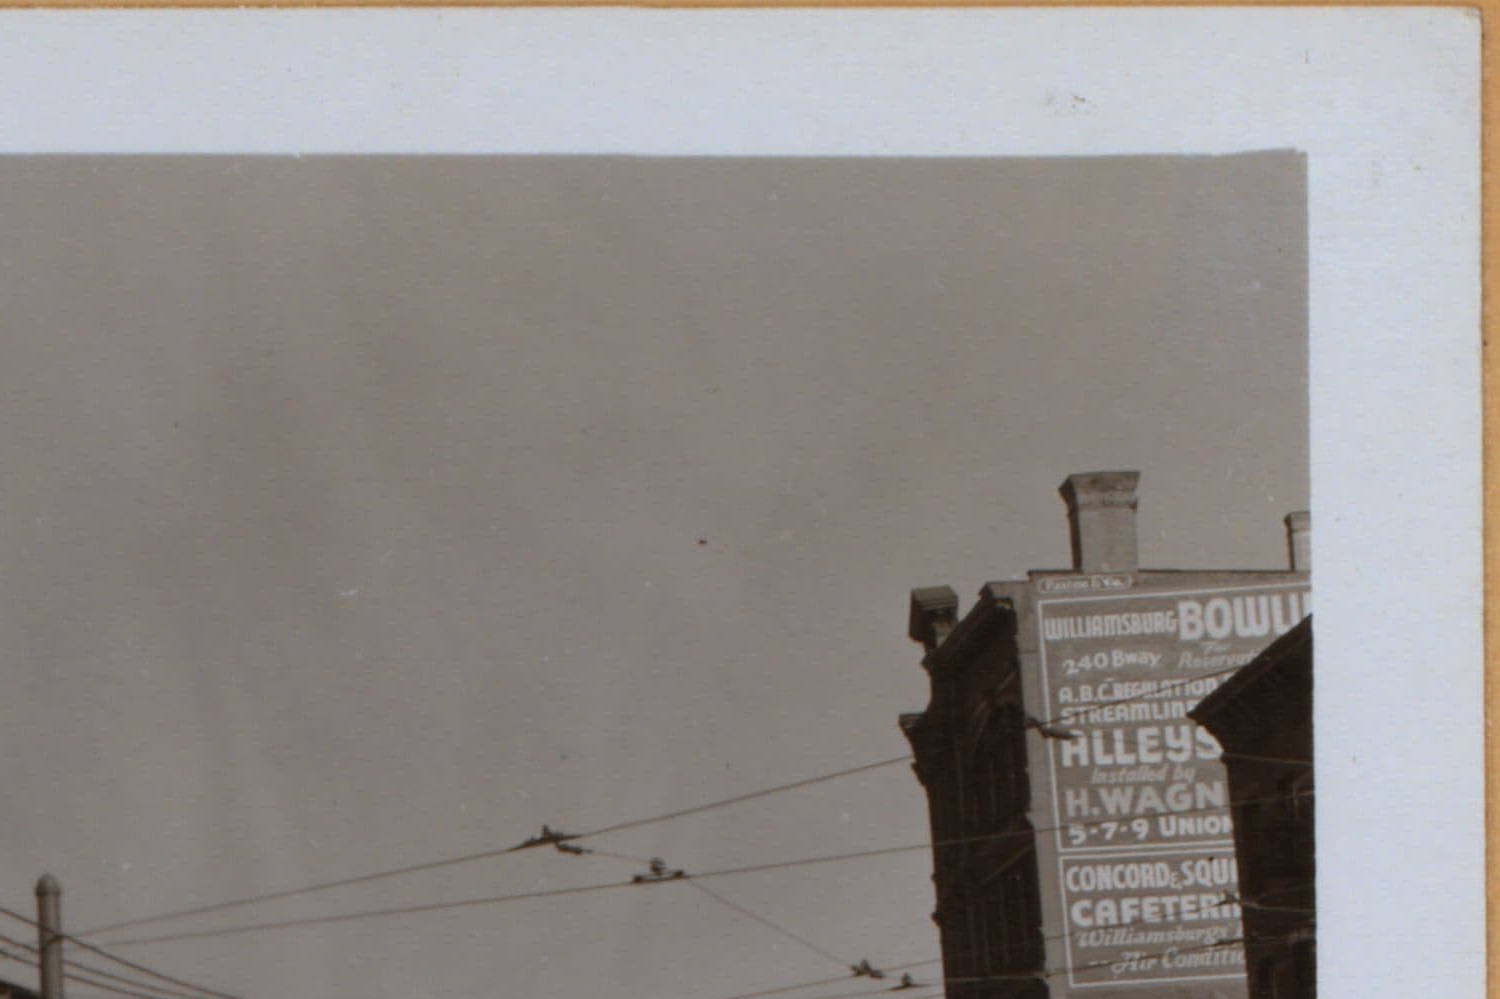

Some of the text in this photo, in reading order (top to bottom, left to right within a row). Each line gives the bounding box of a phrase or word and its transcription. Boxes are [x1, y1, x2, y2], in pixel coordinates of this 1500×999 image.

[1043, 592, 1311, 642] WILLIAMSBURG BOWLI
[1062, 649, 1161, 676] 240 Bway
[1061, 725, 1224, 768] ALLEYS
[1092, 762, 1195, 785] Installed by
[1066, 862, 1170, 892] CONCORD
